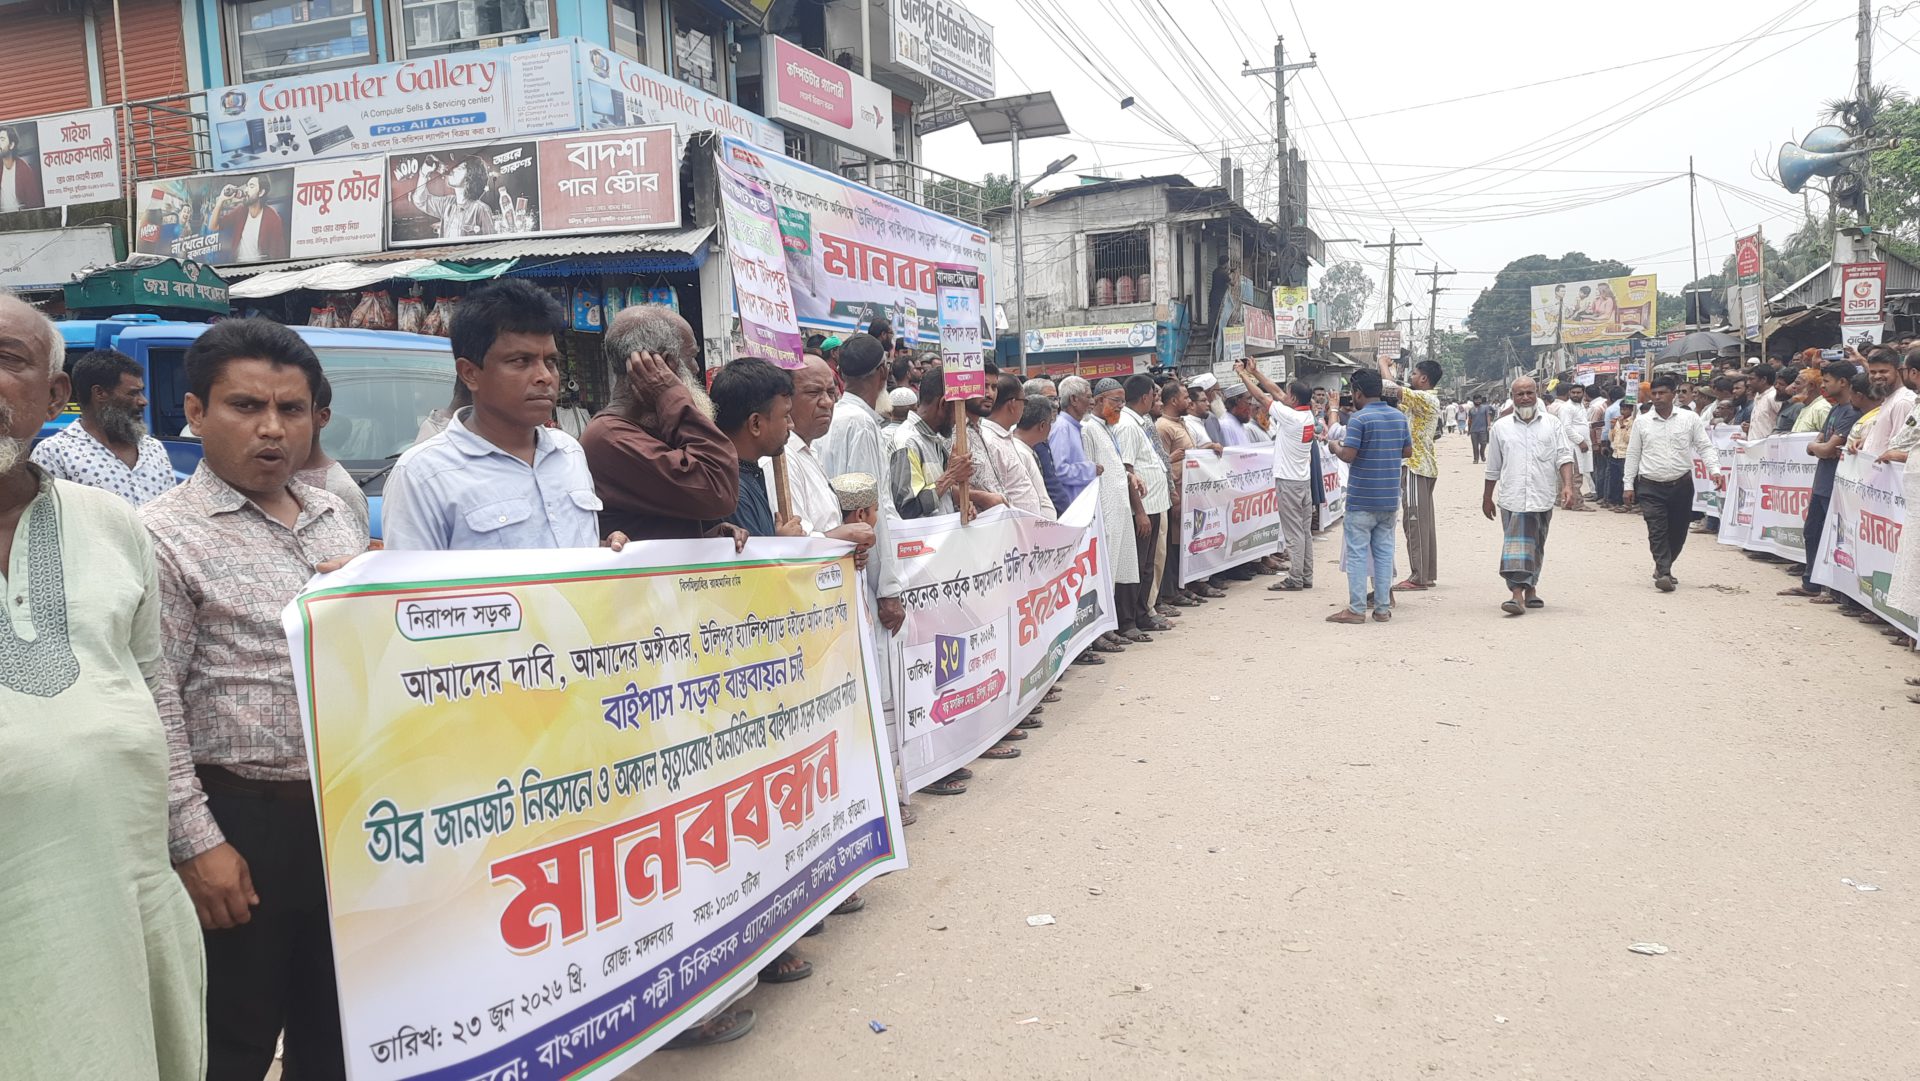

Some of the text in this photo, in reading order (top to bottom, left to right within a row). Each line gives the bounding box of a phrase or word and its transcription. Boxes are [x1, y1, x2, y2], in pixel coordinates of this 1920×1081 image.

[259, 58, 497, 113] Computer Gallery
[618, 60, 700, 117] Computer
[703, 97, 753, 138] Gallery
[370, 107, 404, 118] Computer
[433, 97, 466, 110] Servicing
[468, 94, 494, 105] center)
[60, 121, 91, 142] সাইফা
[377, 115, 476, 134] Pro: Ali Akbar
[43, 137, 113, 167] কনফেকশনারী
[565, 137, 647, 171] বাদশা
[394, 158, 419, 181] MOJO
[558, 169, 659, 197] পান ষ্টোর
[296, 169, 381, 215] বাচ্চু স্টোর
[171, 242, 180, 254] না
[182, 236, 205, 250] খেলে
[205, 233, 219, 246] তো
[888, 219, 916, 244] বাইপাস
[143, 278, 169, 296] জয়
[172, 280, 195, 299] বাবা
[1848, 298, 1877, 310] নগদ
[941, 569, 970, 609] কর্তৃক
[406, 603, 511, 631] নিরাপদ সড়ক
[400, 661, 502, 704] আমাদের
[507, 643, 568, 690] দাবি,
[569, 641, 638, 679] আমাদের
[639, 626, 699, 665] অঙ্গীকার,
[700, 620, 733, 656] উলিপুর
[735, 612, 785, 648] হ্যালিপ্যাড
[786, 609, 806, 641] হইতে
[907, 639, 959, 682] তারিখ: ২৩
[602, 645, 805, 731] বাইপাস সড়ক বাস্তবায়ন চাই
[907, 706, 926, 728] স্থান:
[364, 799, 424, 864] তীব্র
[431, 779, 515, 846] জানজট
[520, 768, 593, 825] নিরসনে
[597, 767, 609, 802] ও
[614, 751, 658, 797] অকাল
[660, 732, 714, 793] মৃত্যুরোধে
[715, 710, 768, 762] অনতিবিলম্বে
[768, 702, 799, 741] বাইপাস
[799, 698, 815, 733] সড়ক
[489, 729, 840, 954] মানববন্ধন
[370, 1025, 443, 1063] তারিখ:
[452, 1017, 482, 1044] ২৩
[488, 999, 515, 1032] জুন
[521, 981, 563, 1016] ২০২৬
[602, 947, 632, 977] রোজ:
[634, 921, 674, 959] মঙ্গলবার
[693, 900, 714, 925] সময়:
[741, 870, 761, 899] ঘটিকা
[536, 994, 637, 1069] বাংলাদেশ
[643, 968, 675, 1009] পল্লী
[679, 931, 739, 990] চিকিৎসক
[811, 855, 837, 888] উলিপুর
[837, 832, 873, 867] উপজেলা
